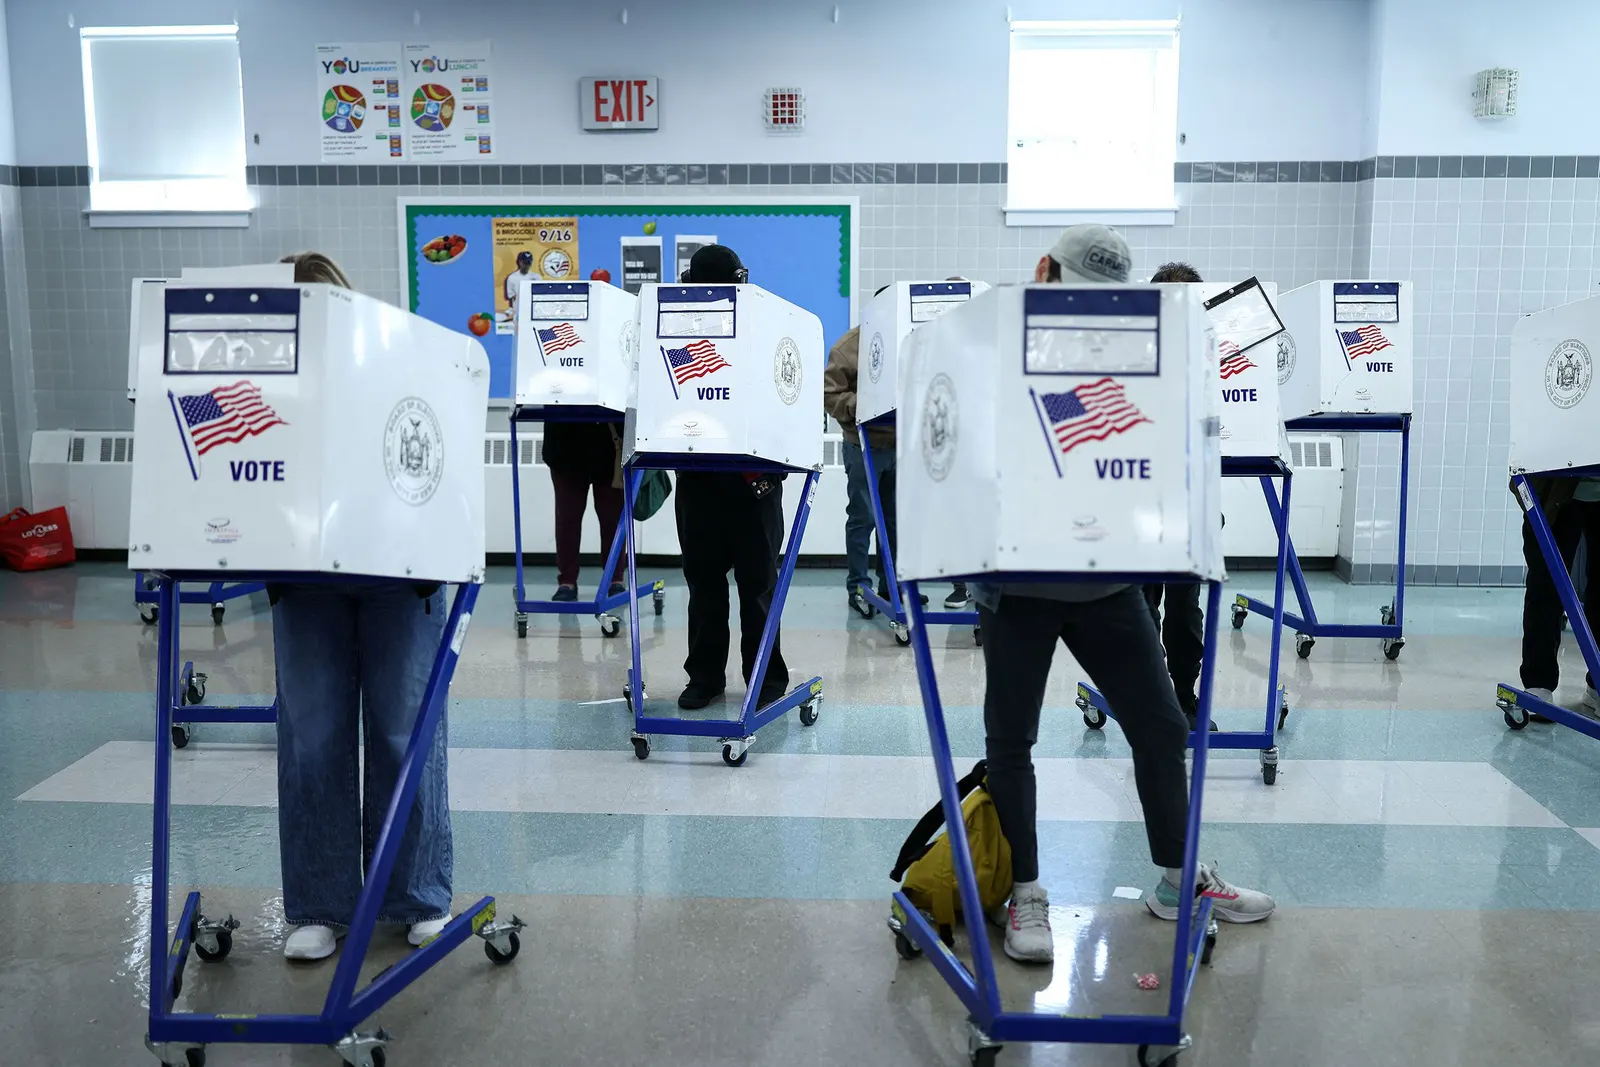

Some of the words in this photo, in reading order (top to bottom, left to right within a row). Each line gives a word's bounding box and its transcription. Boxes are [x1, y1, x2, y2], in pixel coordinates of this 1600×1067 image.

[594, 80, 647, 122] EXIT
[540, 230, 571, 241] 9/16
[559, 357, 584, 367] VOTE
[1366, 362, 1393, 372] VOTE
[697, 387, 730, 400] VOTE
[1222, 389, 1257, 402] VOTE
[230, 461, 285, 482] VOTE
[1095, 459, 1150, 479] VOTE
